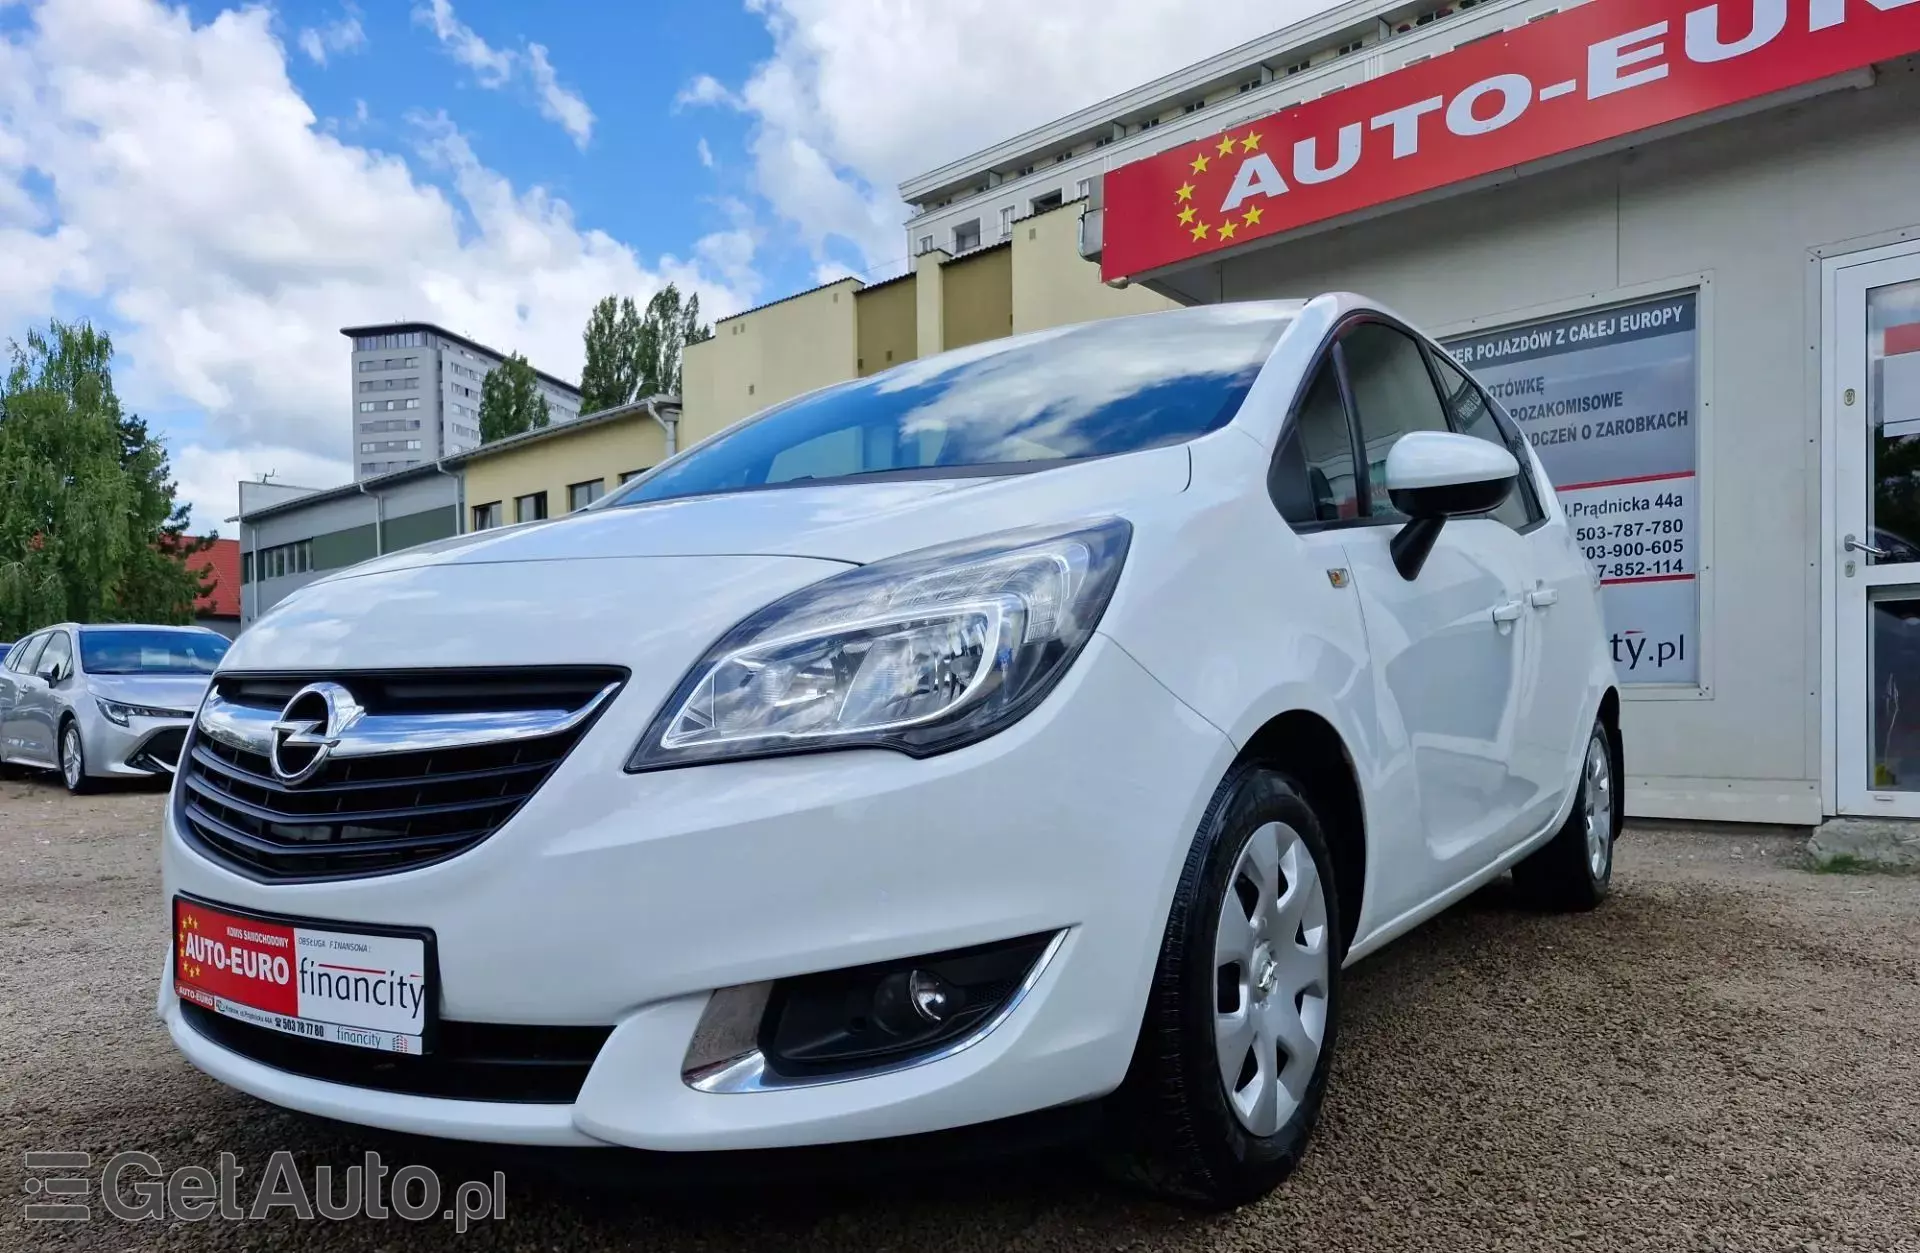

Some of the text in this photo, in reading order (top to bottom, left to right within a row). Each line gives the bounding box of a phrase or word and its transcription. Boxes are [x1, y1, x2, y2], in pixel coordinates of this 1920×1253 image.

[1477, 331, 1551, 361] POJAZDÓW
[1556, 330, 1565, 345] Z
[1569, 320, 1616, 342] CAŁEJ
[1620, 305, 1683, 331] EUROPY
[1510, 391, 1623, 421] POZAKOMISOWE
[1581, 424, 1592, 440] O
[1596, 410, 1688, 438] ZAROBKACH
[1654, 493, 1683, 509] 44a
[1576, 519, 1684, 541] 503-787-780
[1581, 539, 1684, 560] 03-900-605
[185, 932, 290, 985] AUTO-EURO
[299, 957, 425, 1019] financity
[282, 1018, 296, 1032] 503
[314, 1025, 325, 1038] 80
[337, 1026, 382, 1048] financity
